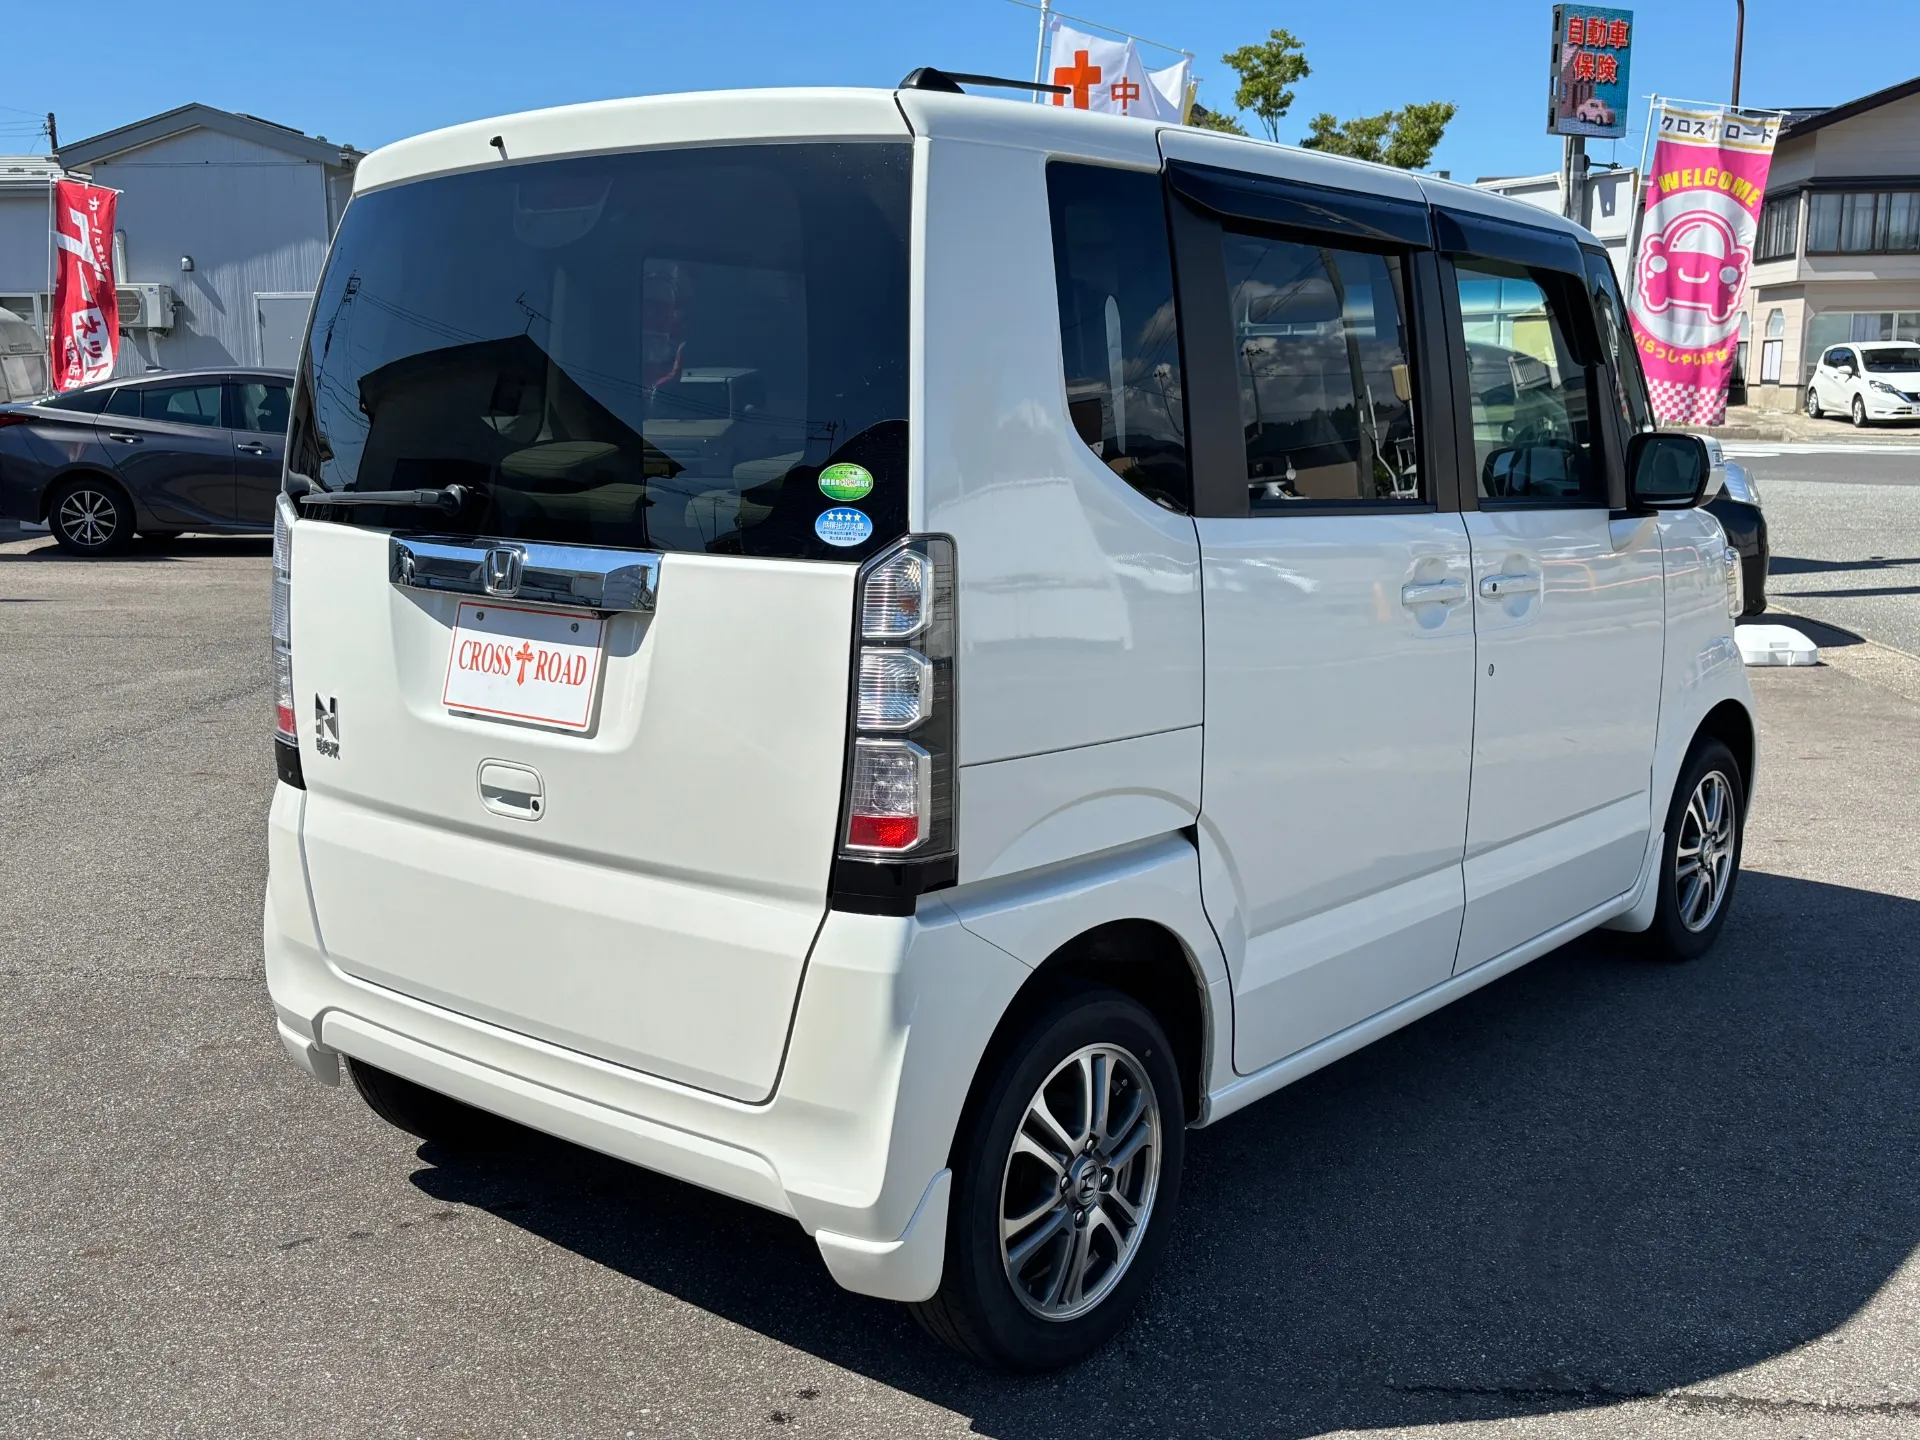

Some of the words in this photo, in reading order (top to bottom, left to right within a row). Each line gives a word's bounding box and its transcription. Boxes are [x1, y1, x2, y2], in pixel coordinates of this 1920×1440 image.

[1567, 16, 1628, 48] 自動車
[1574, 51, 1618, 84] 保険
[1661, 115, 1706, 136] クロス
[1725, 124, 1774, 144] ロード
[1658, 167, 1761, 208] WELCOME
[458, 639, 514, 676] CROSS
[533, 649, 588, 687] ROAD
